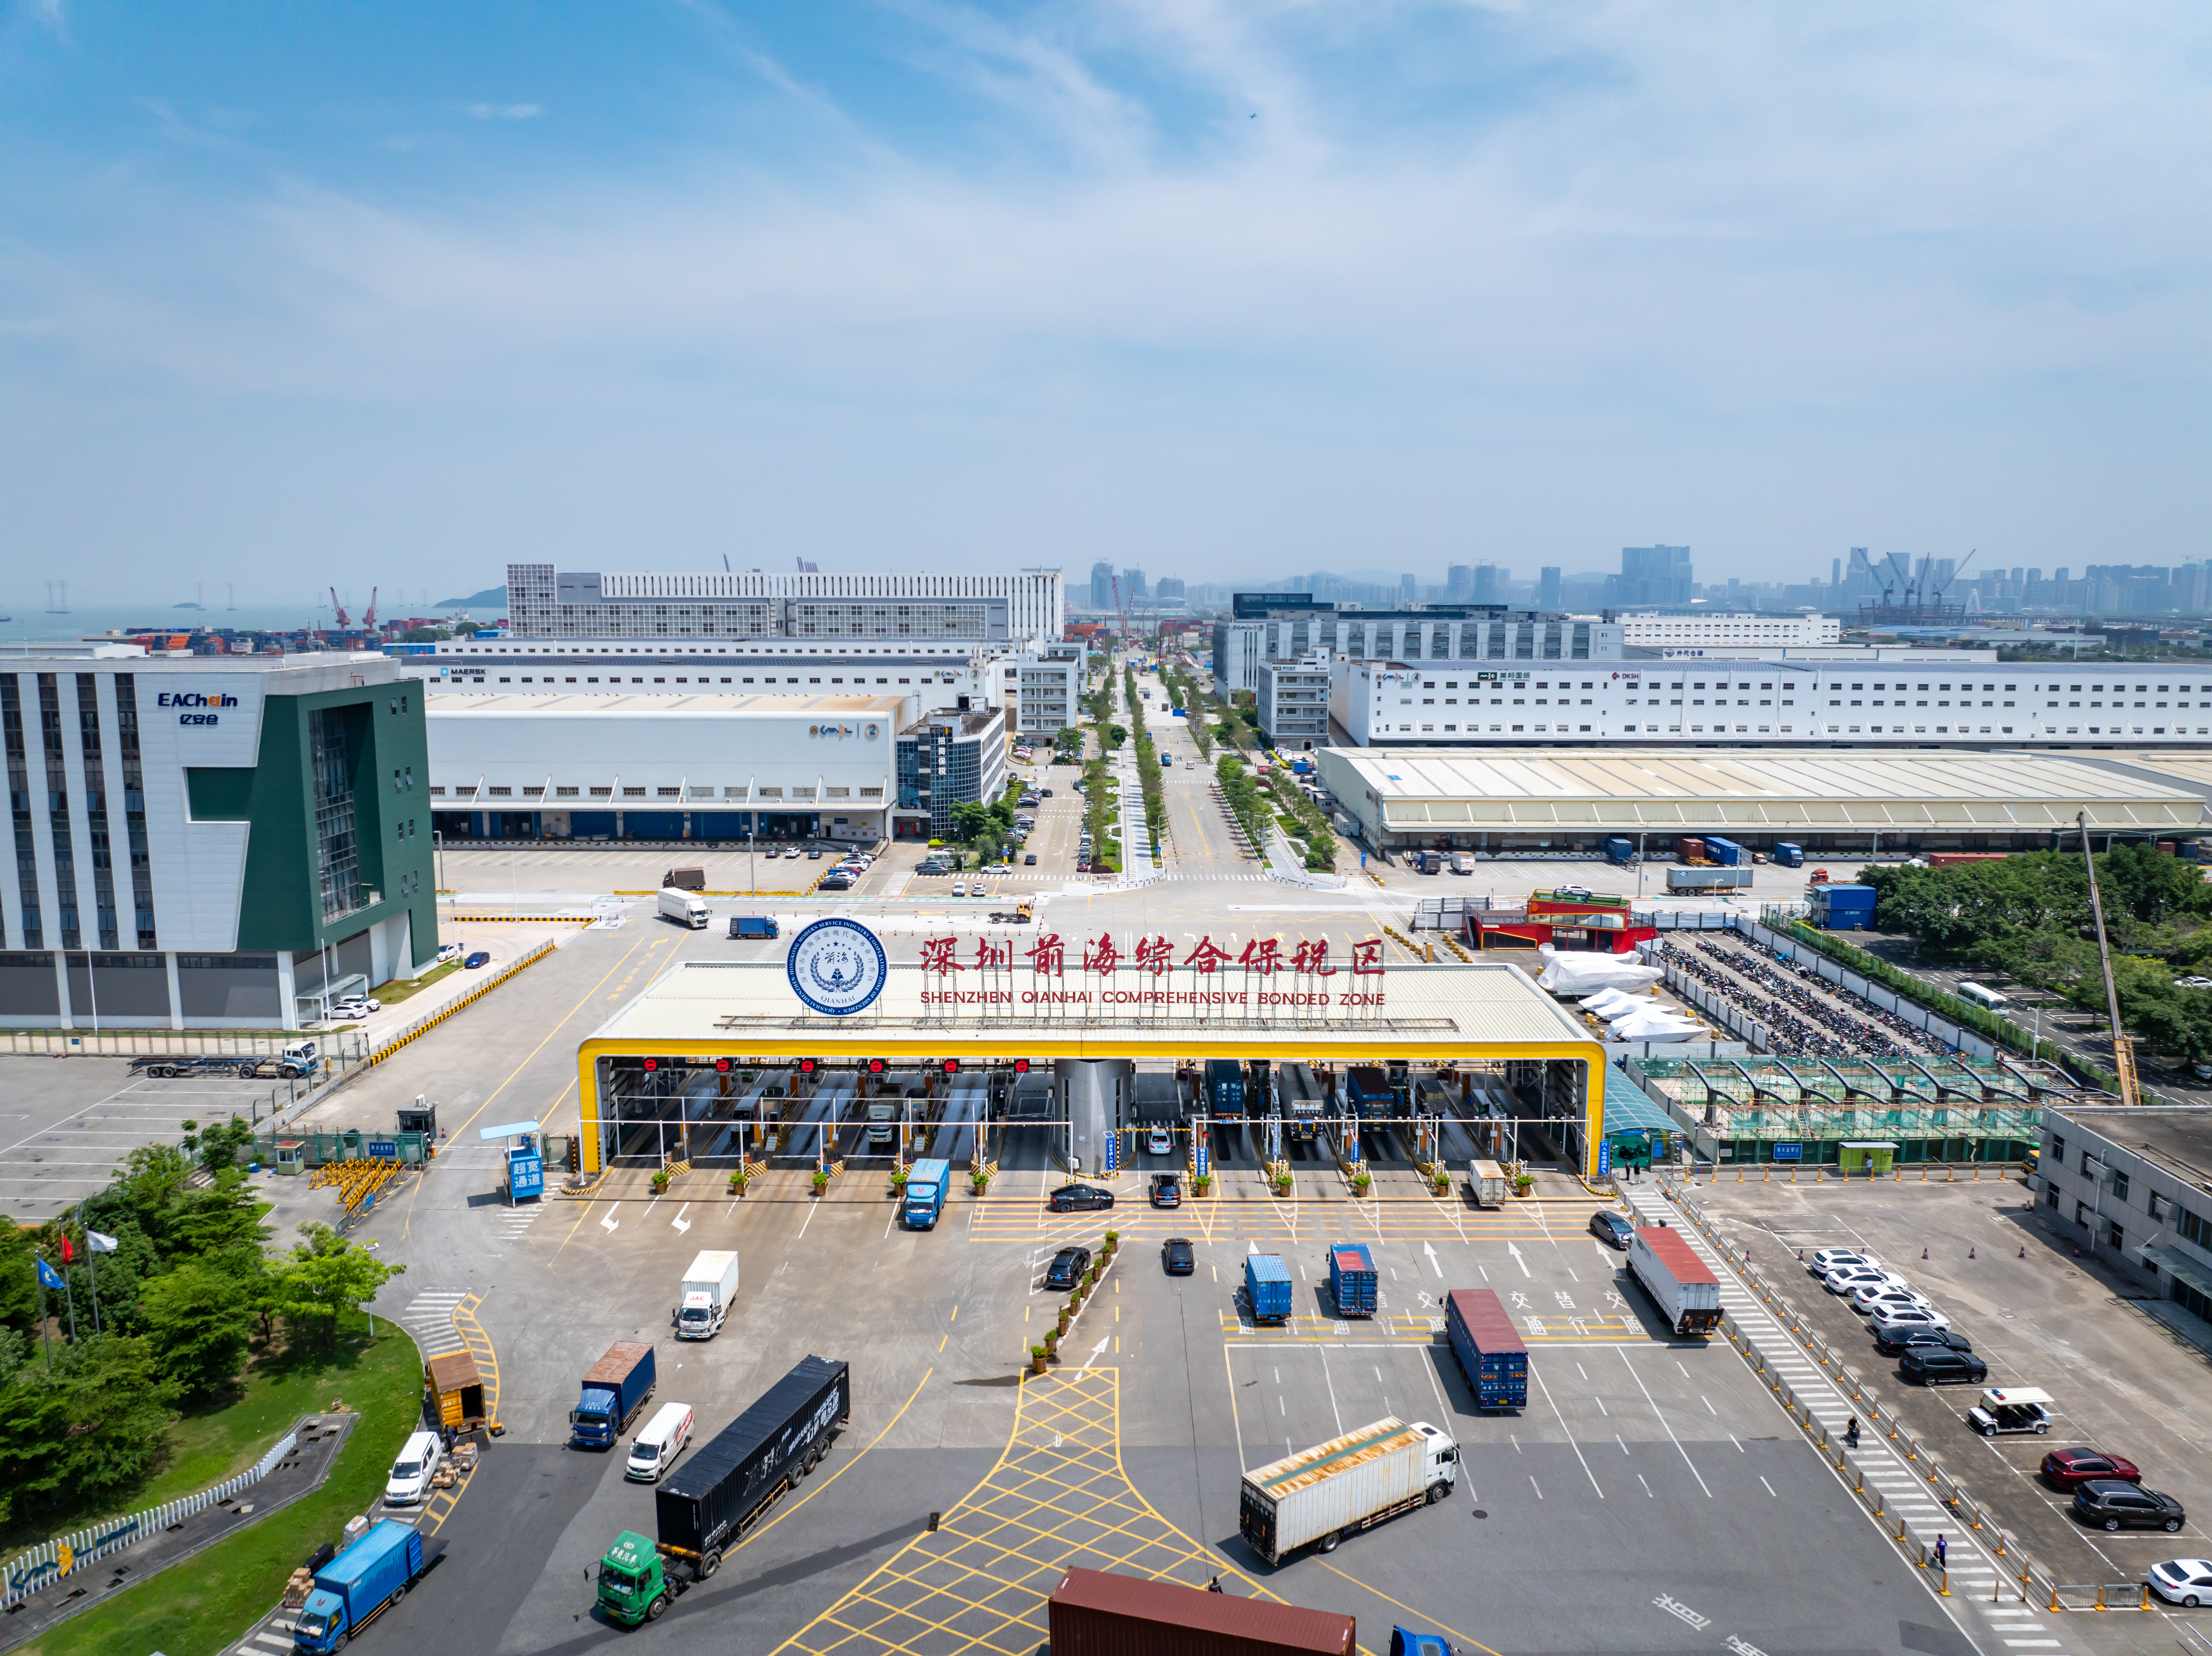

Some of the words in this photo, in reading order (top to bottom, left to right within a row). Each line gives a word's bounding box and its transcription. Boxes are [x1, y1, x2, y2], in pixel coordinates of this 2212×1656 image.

[158, 693, 237, 707] EAChain
[180, 714, 219, 724] 亿安仓
[938, 737, 946, 776] 招商保税
[798, 925, 818, 942] MODERN
[843, 922, 870, 939] INDUSTRY
[869, 937, 885, 976] COOPERATION
[918, 932, 1385, 978] 深圳前海综合保税区
[874, 976, 884, 992] ZONE
[821, 995, 856, 1004] QIANHAI
[921, 991, 1012, 1004] SHENZHEN
[1022, 991, 1092, 1004] QIANHAI
[1103, 991, 1248, 1004] COMPREHENSIVE
[1259, 992, 1330, 1005] BONDED
[1340, 993, 1385, 1005] ZONE
[514, 1160, 540, 1175] 超宽
[514, 1174, 541, 1188] 通道
[1603, 1290, 1630, 1309] 交
[1619, 1315, 1647, 1335] 通
